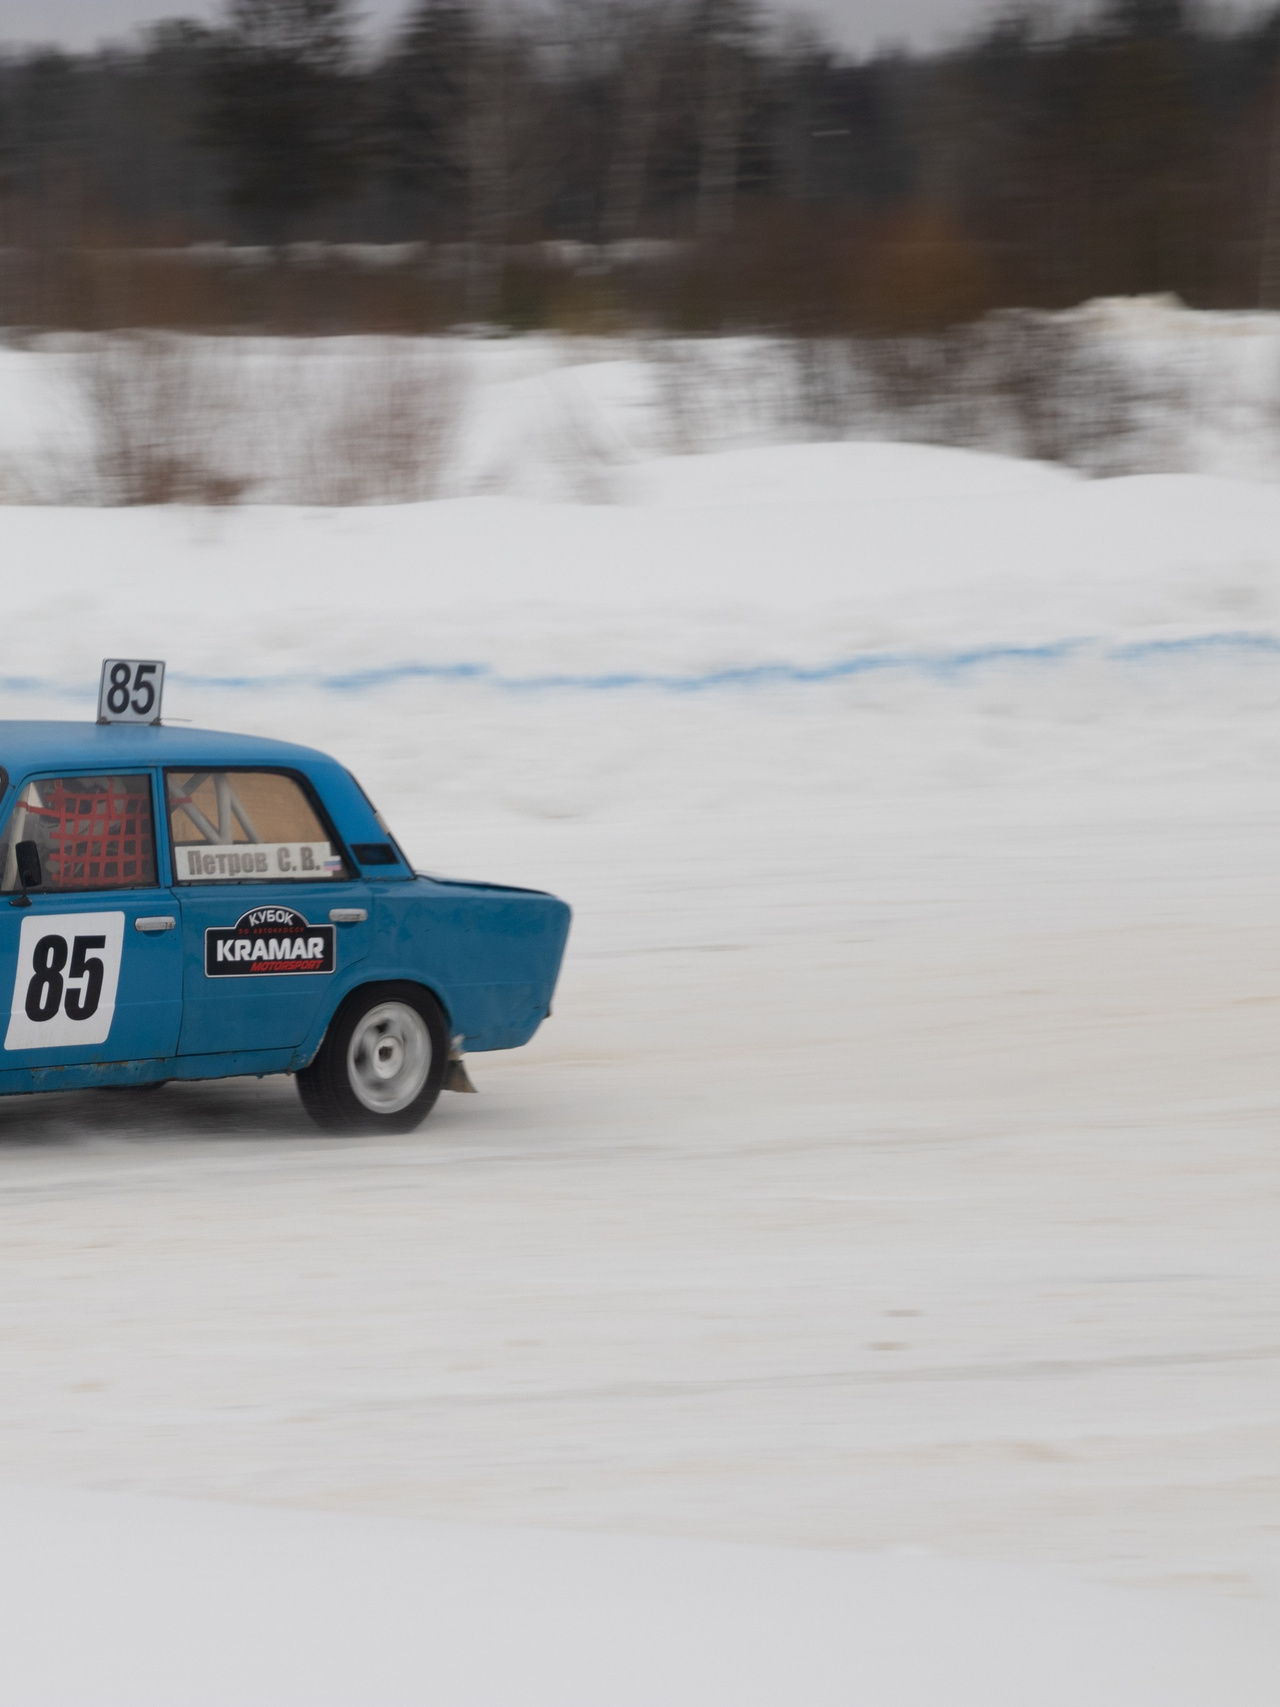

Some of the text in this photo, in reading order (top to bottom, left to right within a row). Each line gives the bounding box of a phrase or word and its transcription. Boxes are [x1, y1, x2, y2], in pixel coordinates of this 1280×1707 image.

[107, 662, 156, 715] 85
[187, 850, 269, 876] Петров
[249, 910, 294, 926] КУБОК
[216, 937, 324, 961] KRAMAR
[25, 934, 106, 1022] 85
[250, 960, 323, 972] MOTORSPORT
